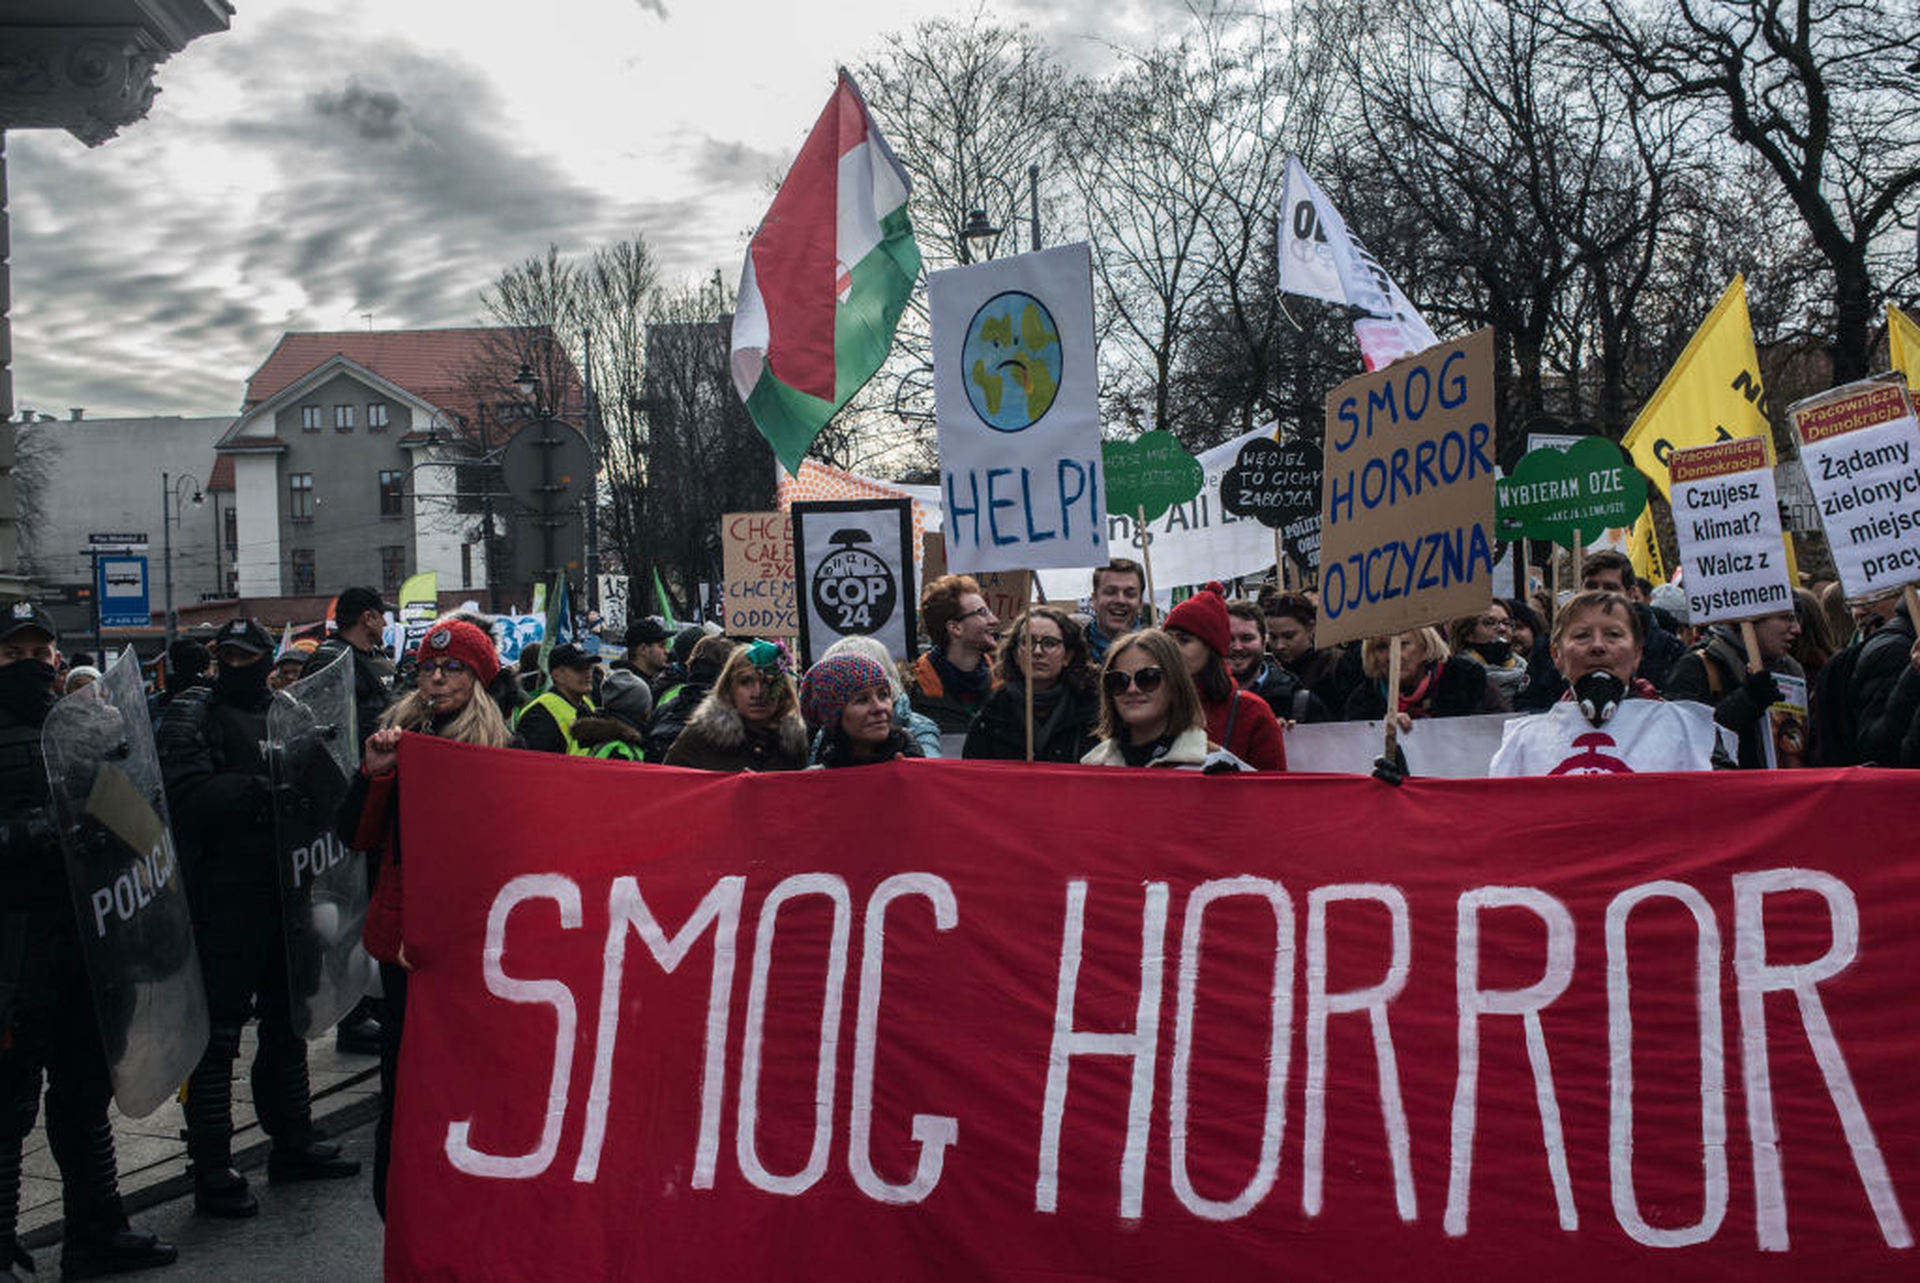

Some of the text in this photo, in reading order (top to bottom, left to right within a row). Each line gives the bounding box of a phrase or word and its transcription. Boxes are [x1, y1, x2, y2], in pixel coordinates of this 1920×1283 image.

[1334, 350, 1467, 452] SMOG
[1800, 388, 1898, 427] Pracownicza
[1808, 405, 1900, 440] Demokracja
[1672, 441, 1761, 465] Pracownicza
[1677, 456, 1761, 480] Demokracja
[1818, 441, 1910, 481] Żądamy
[1240, 470, 1322, 486] TO CICHY
[1330, 422, 1493, 525] HORROR
[1500, 468, 1624, 507] WYBIERAM OZE
[947, 459, 1099, 547] HELP!
[1165, 494, 1209, 533] All
[1239, 487, 1314, 507] ZABÓJCA
[1687, 483, 1760, 509] Czujesz
[1693, 511, 1761, 541] klimat?
[1323, 522, 1493, 619] OJCZYZNA
[1697, 552, 1769, 577] Walcz z
[820, 578, 887, 606] COP
[1691, 584, 1787, 616] systemem
[838, 604, 871, 627] 24
[292, 832, 349, 888] POLI
[445, 867, 1915, 1253] SMOG HORROR
